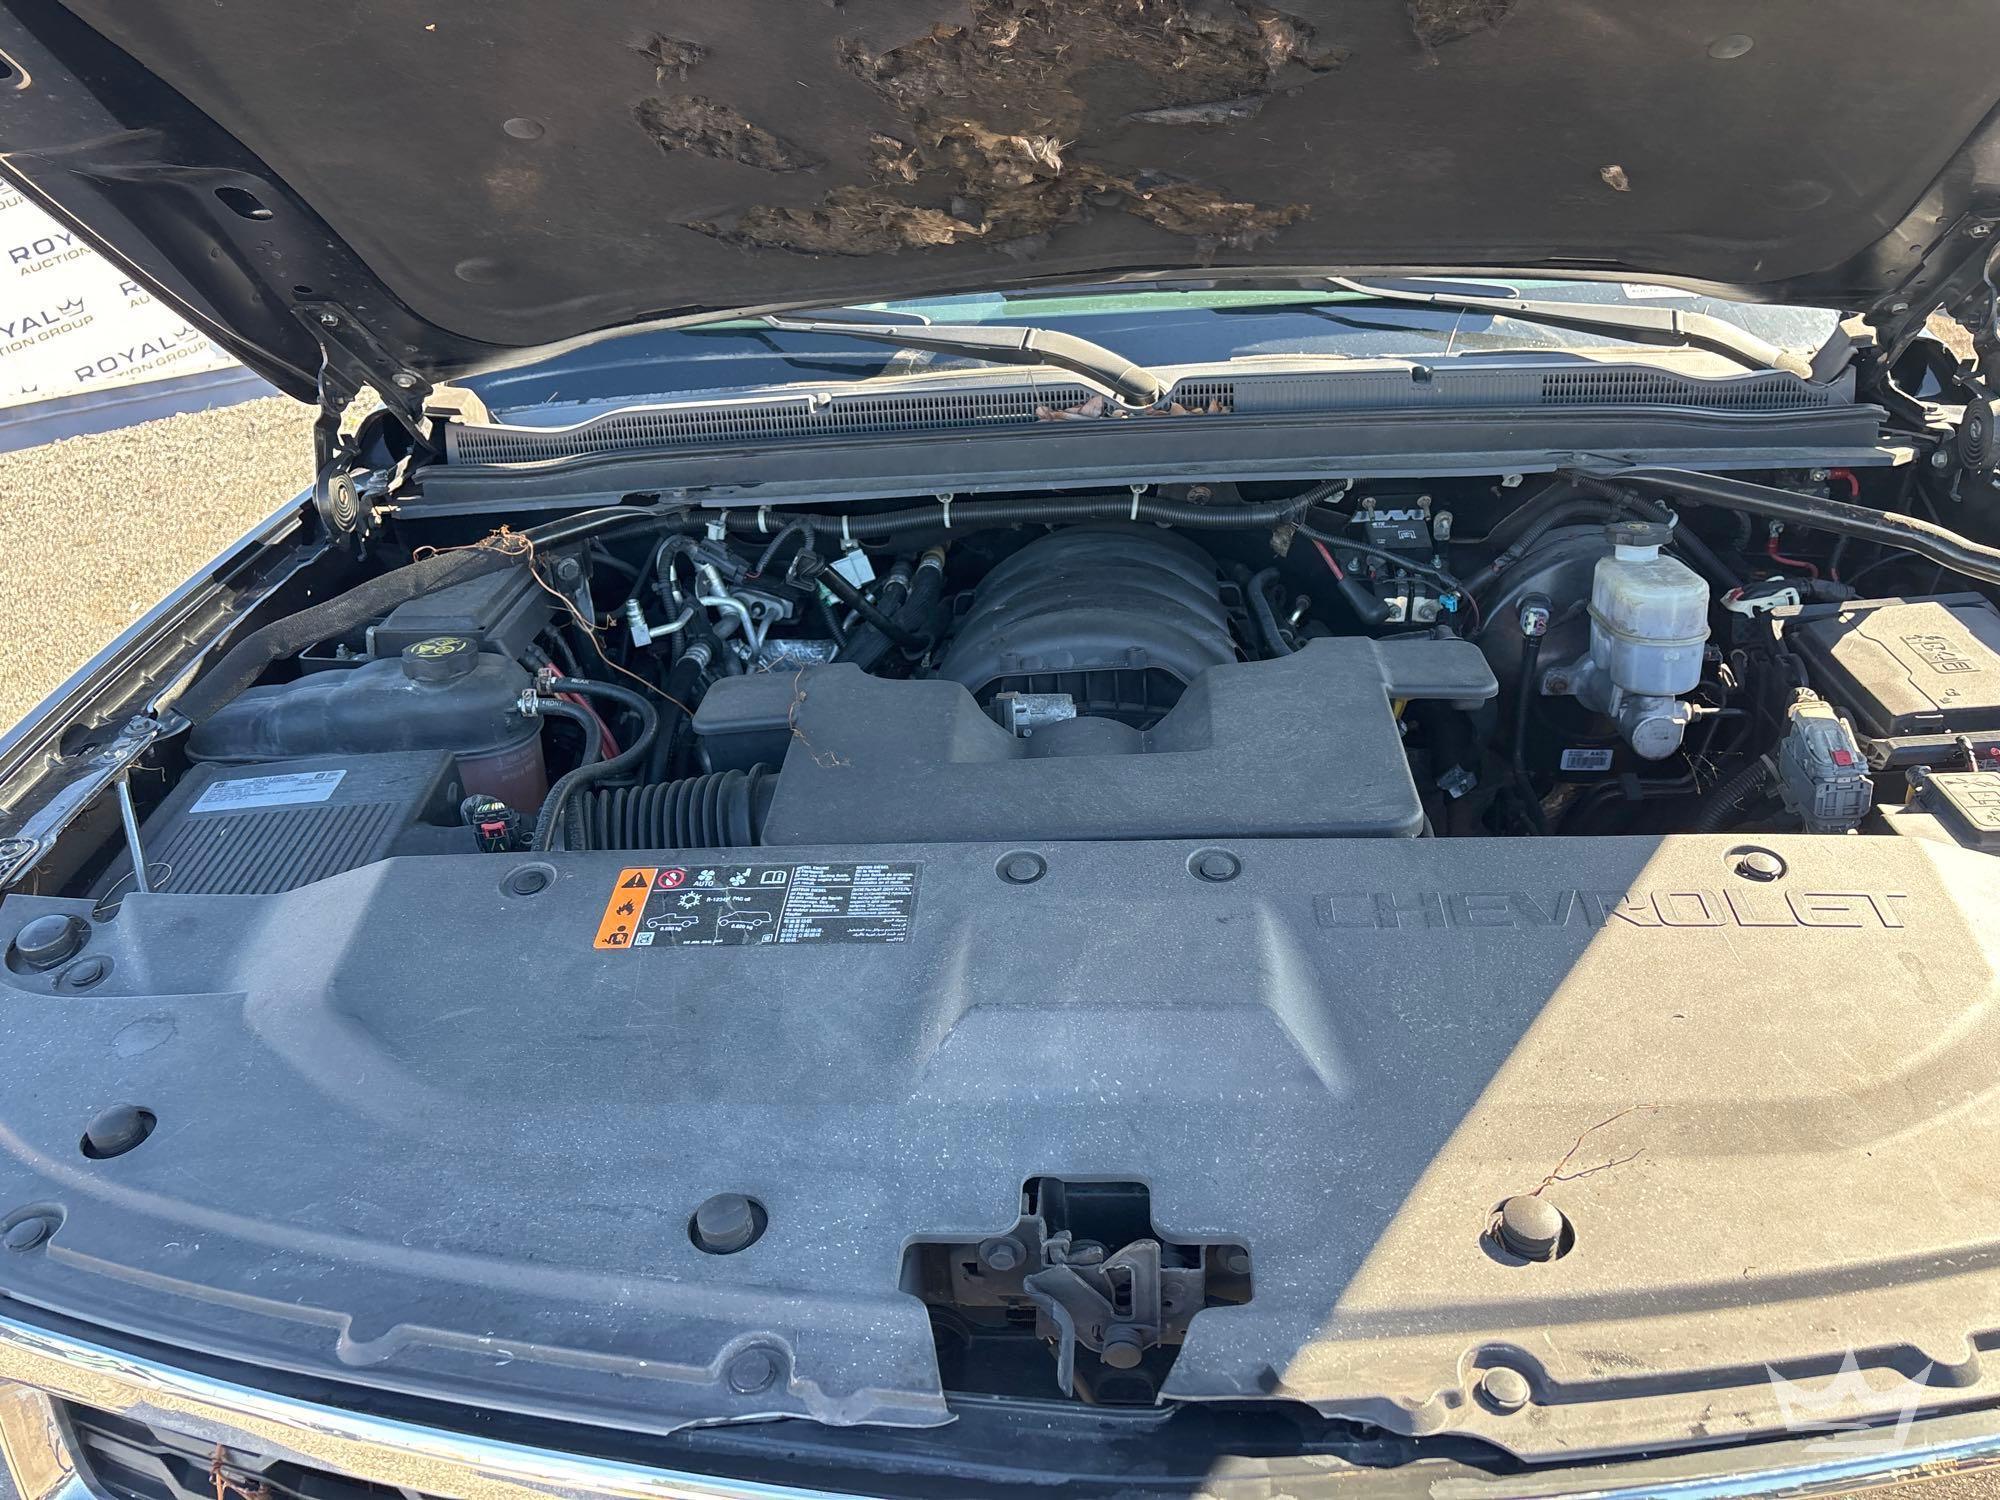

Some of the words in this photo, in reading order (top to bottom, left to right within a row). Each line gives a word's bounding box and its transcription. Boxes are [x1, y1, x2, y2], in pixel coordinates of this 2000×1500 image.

[8, 233, 71, 264] ROY
[0, 311, 60, 338] YAL
[0, 339, 35, 356] TION
[38, 315, 94, 342] GROUP
[74, 337, 177, 382] ROYAL
[156, 340, 207, 366] GROUP
[1312, 888, 1907, 929] CHEVROLET
